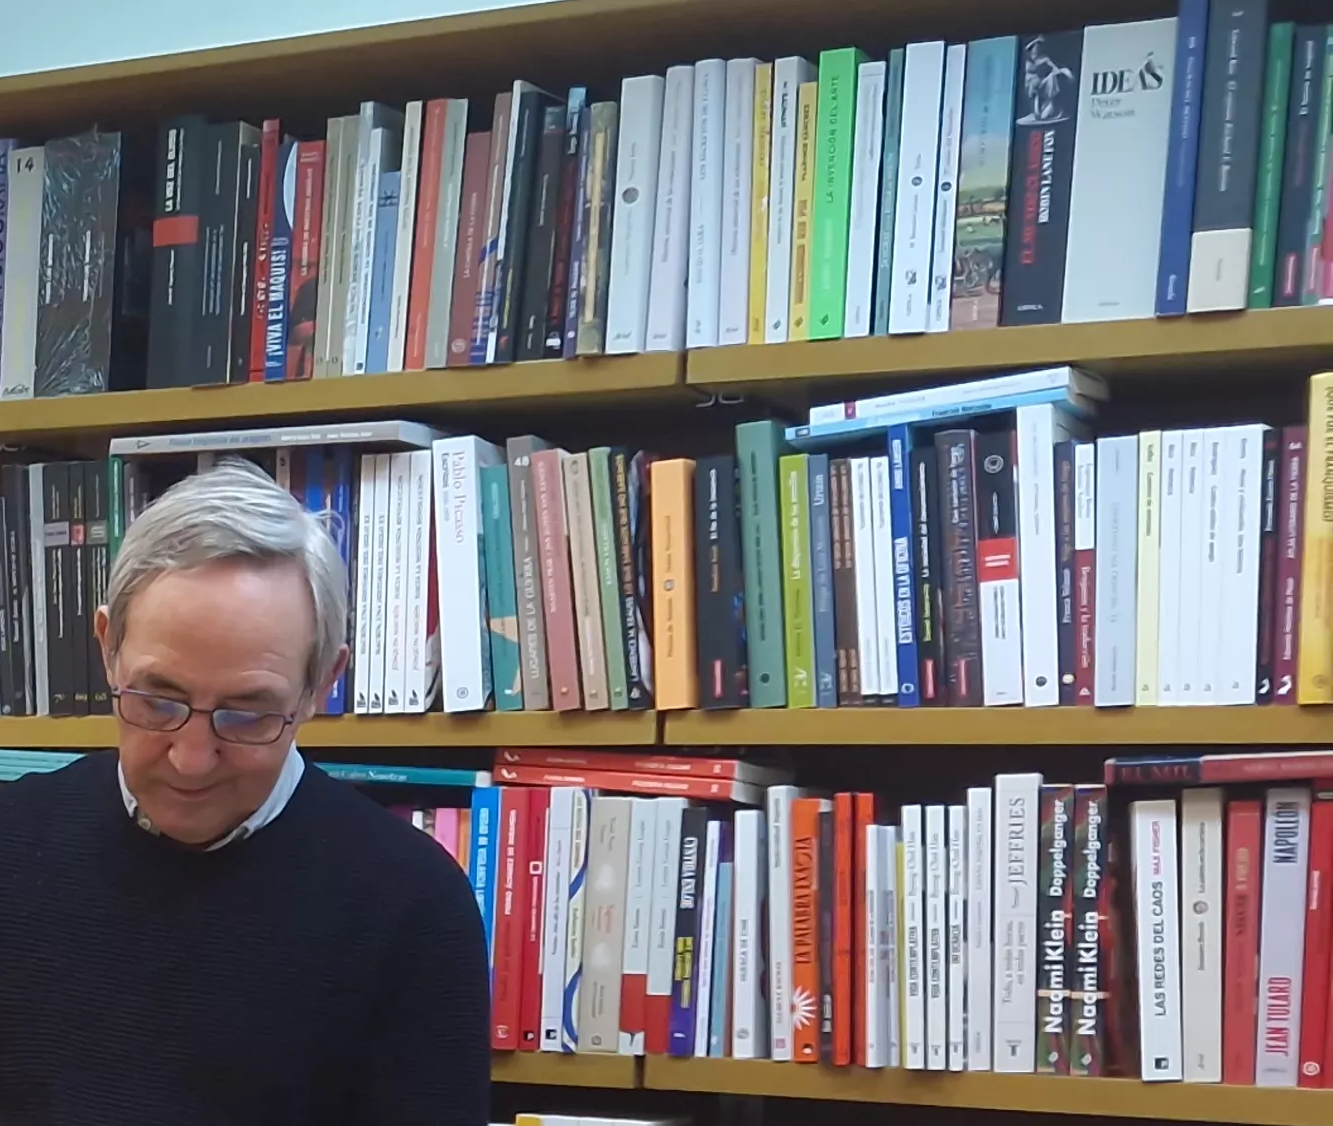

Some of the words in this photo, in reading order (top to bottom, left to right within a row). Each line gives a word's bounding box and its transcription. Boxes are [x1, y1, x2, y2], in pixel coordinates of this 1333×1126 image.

[15, 156, 36, 173] 14
[267, 302, 284, 320] EL
[450, 450, 466, 492] Pablo
[1008, 795, 1027, 888] JEFFRIES
[1048, 798, 1068, 898] Doppelganger
[1081, 800, 1101, 899] Doppelganger
[1271, 801, 1300, 866] NAPOLEÓN
[1152, 880, 1164, 918] CAOS
[1045, 909, 1065, 961] Klein
[1078, 910, 1098, 962] Klein
[1153, 923, 1165, 945] DEL
[1154, 949, 1166, 987] REDES
[1044, 962, 1065, 1035] Naomi
[1077, 963, 1099, 1036] Naomi
[1154, 992, 1167, 1017] LAS
[1265, 976, 1293, 1018] TULARD
[1263, 1020, 1290, 1057] JEAN
